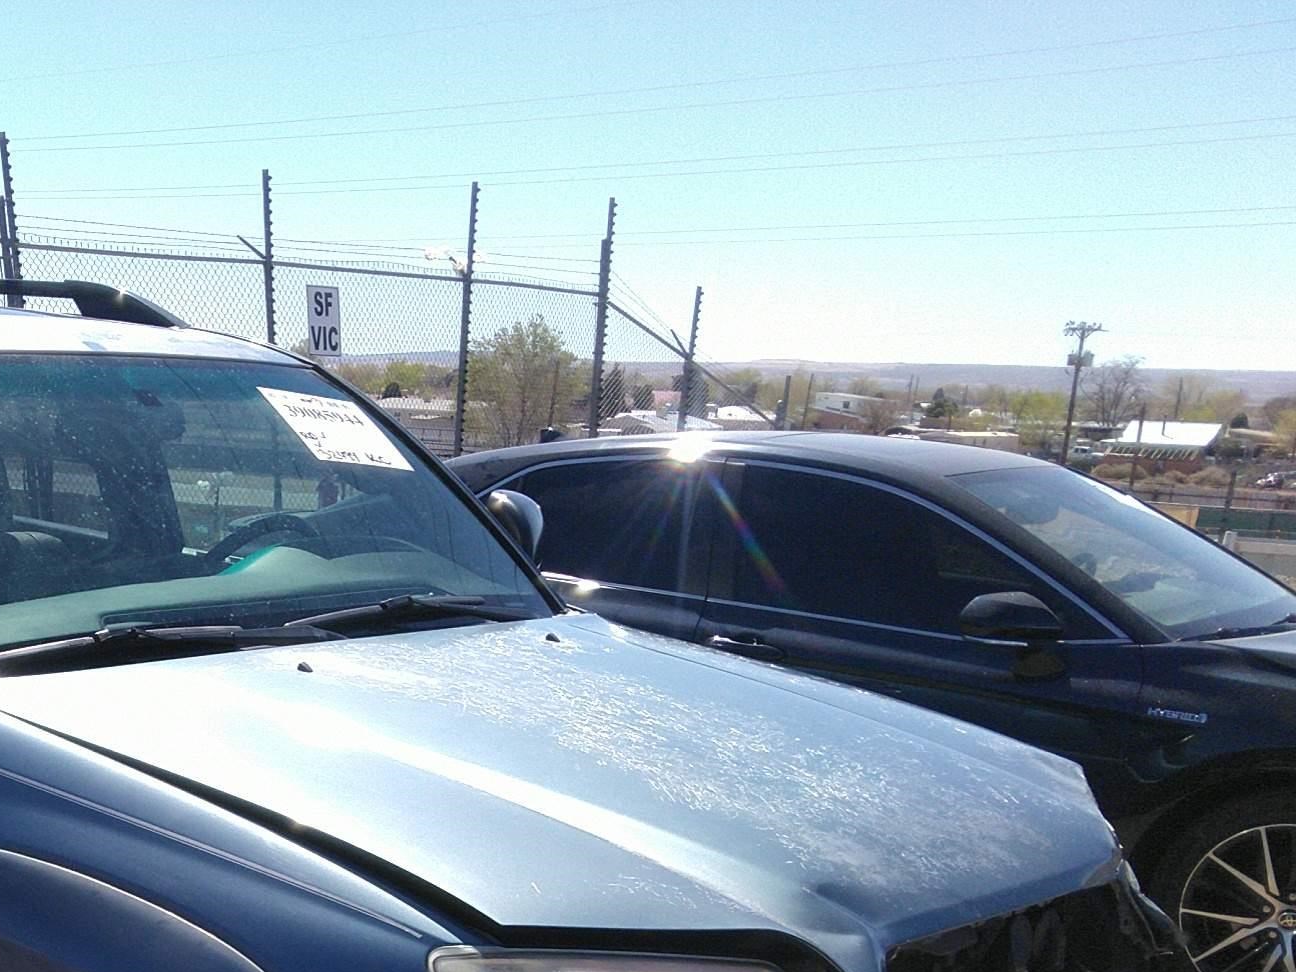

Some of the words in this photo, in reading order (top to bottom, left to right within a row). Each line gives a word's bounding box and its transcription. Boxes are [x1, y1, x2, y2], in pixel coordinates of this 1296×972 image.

[314, 291, 333, 317] SF
[311, 325, 338, 352] VIC
[1147, 707, 1207, 723] HYBRID
